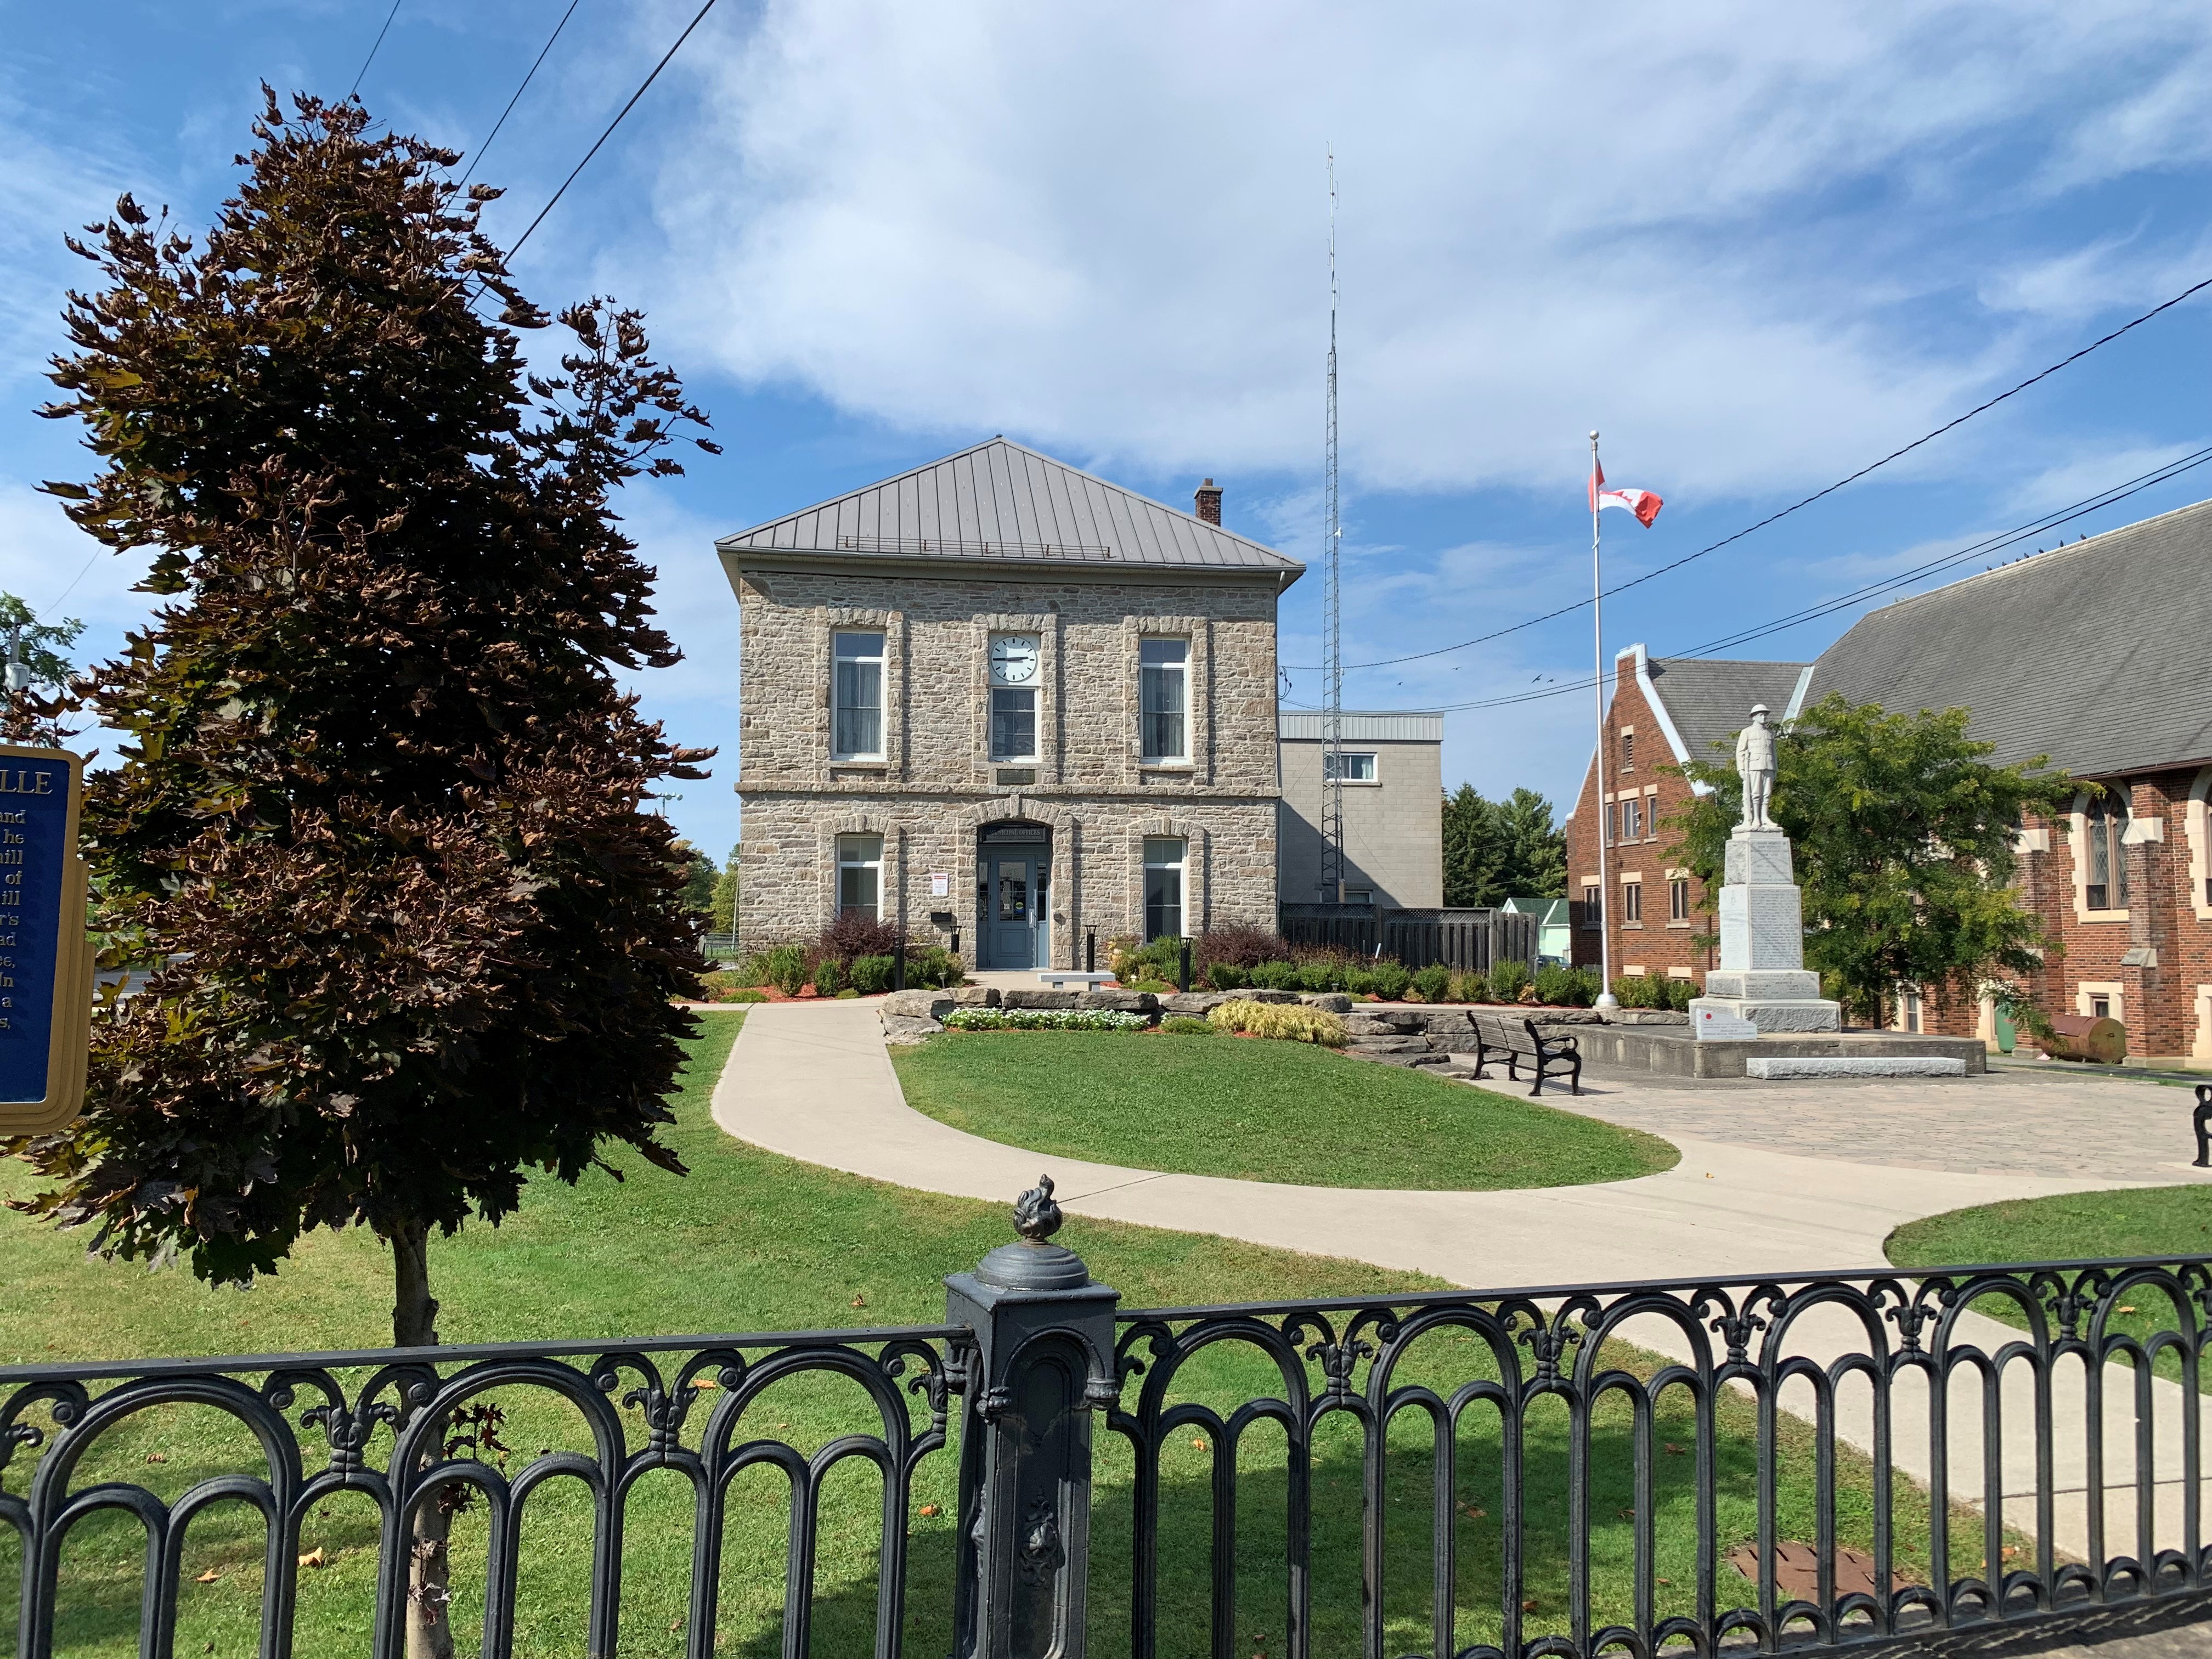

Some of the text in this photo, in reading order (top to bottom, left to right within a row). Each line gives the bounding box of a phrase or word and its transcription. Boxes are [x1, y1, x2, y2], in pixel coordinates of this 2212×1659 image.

[3, 829, 25, 844] he
[0, 850, 23, 865] ill
[5, 870, 22, 885] of
[2, 890, 20, 905] ill
[0, 912, 19, 926] r's
[2, 997, 12, 1008] a
